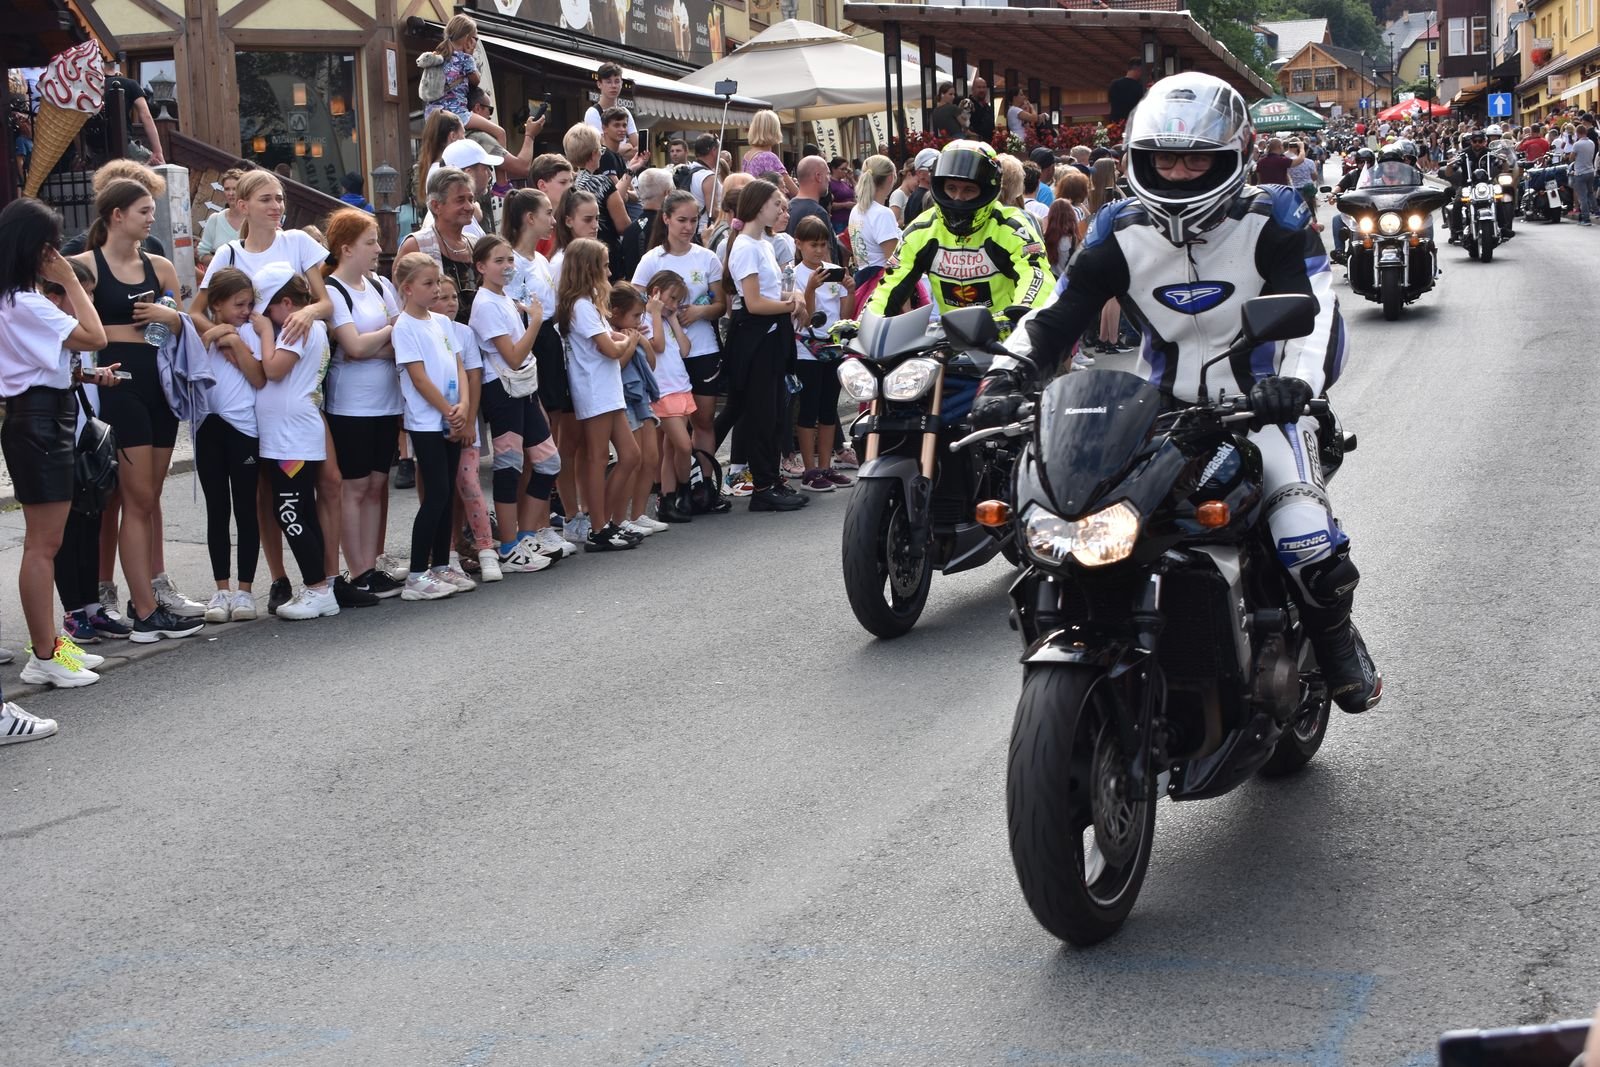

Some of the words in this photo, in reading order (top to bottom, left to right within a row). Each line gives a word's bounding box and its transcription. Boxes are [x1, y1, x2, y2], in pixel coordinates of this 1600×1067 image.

[942, 251, 984, 266] Nastro
[937, 264, 990, 278] Azzurro
[1064, 406, 1107, 415] Kawasaki
[279, 491, 303, 537] ikee
[1281, 533, 1328, 550] TEKNIC
